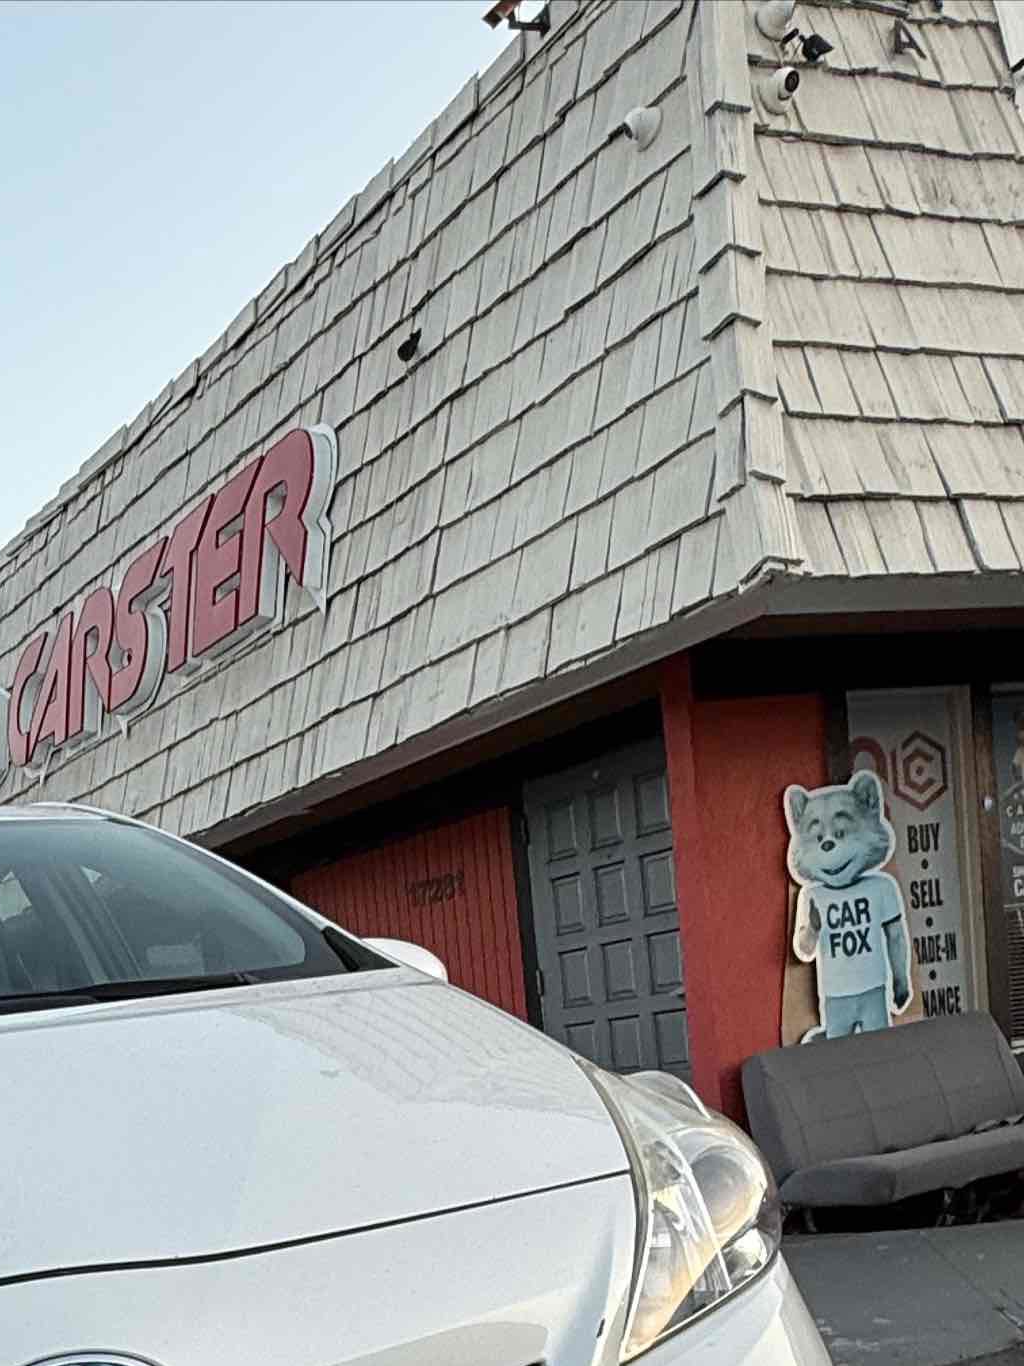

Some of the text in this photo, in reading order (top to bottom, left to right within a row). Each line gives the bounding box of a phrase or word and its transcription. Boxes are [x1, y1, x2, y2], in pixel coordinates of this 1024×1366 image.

[8, 427, 326, 769] CARSTER
[907, 822, 940, 853] BUY
[910, 878, 944, 910] SELL
[827, 897, 871, 929] CAR
[830, 927, 872, 958] FOX
